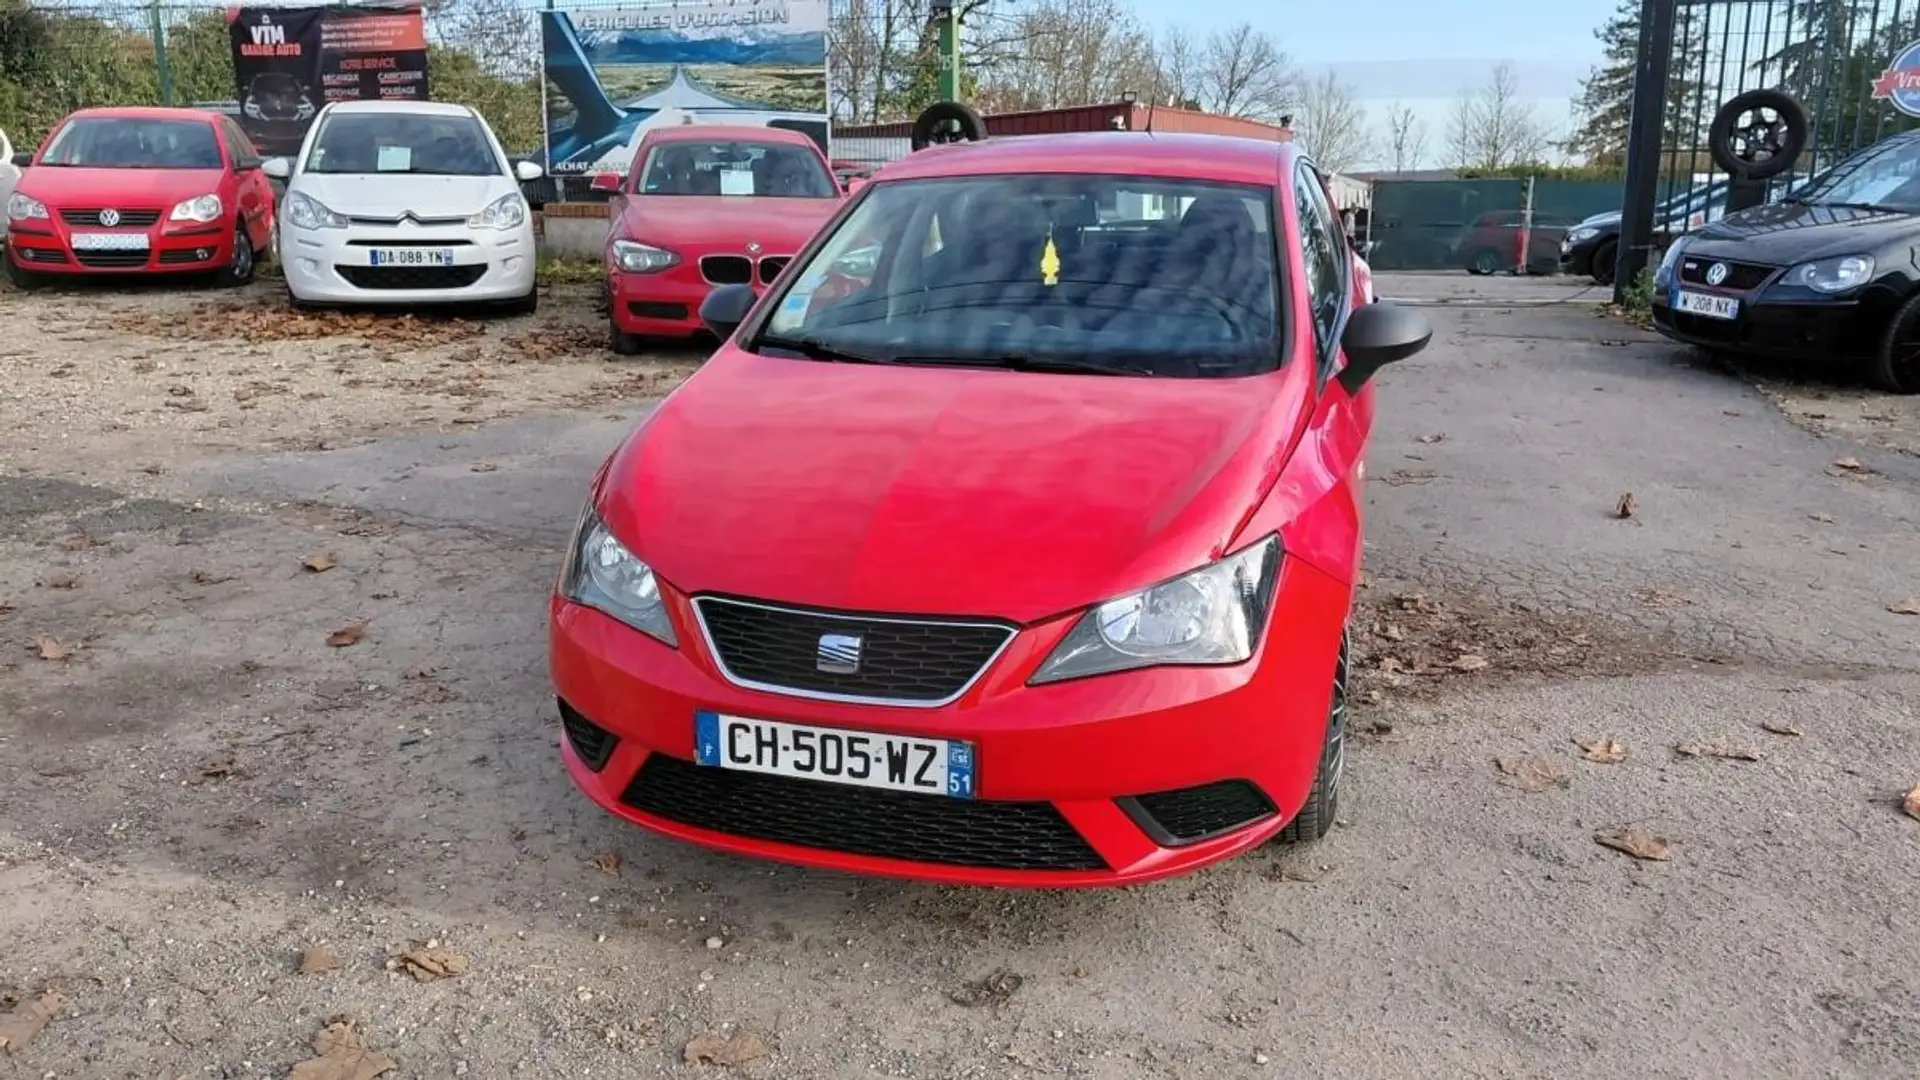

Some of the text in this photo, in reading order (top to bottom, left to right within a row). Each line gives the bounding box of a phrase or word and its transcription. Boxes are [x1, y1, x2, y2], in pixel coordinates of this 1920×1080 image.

[250, 24, 285, 45] VTM
[241, 43, 302, 56] GARAGE AUTO
[705, 743, 714, 757] F
[728, 722, 938, 787] CH-505-WZ
[949, 771, 971, 794] 51
